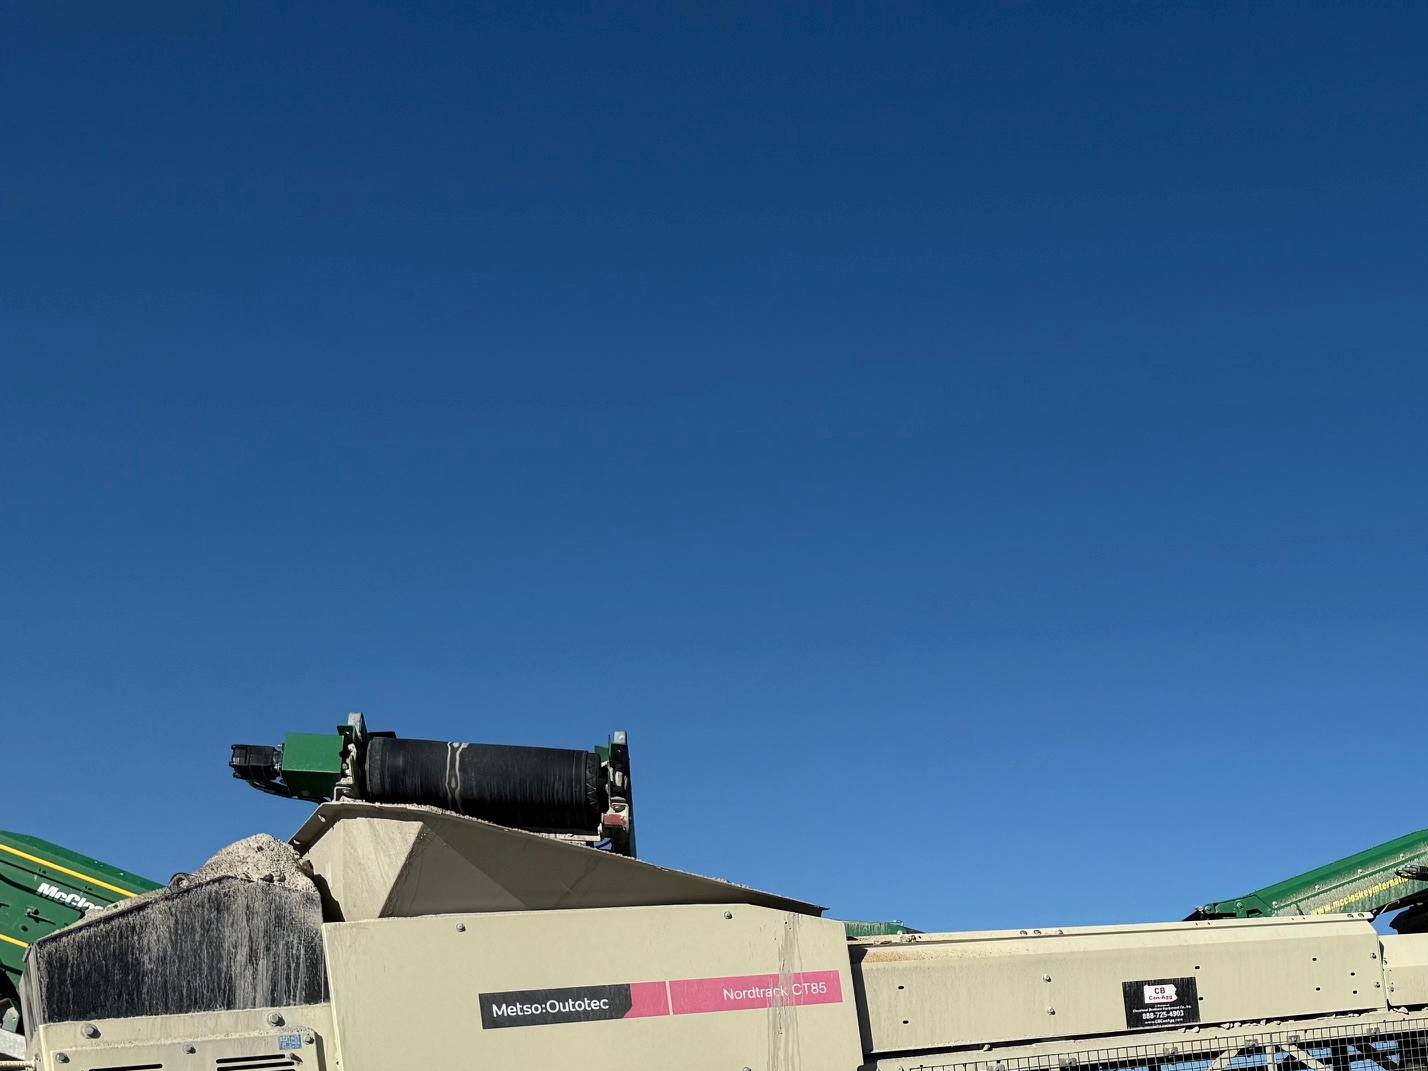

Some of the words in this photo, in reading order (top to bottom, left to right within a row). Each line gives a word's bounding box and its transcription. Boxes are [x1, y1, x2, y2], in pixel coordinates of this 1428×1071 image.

[722, 984, 789, 1000] Nordtrack
[792, 982, 828, 996] CT85
[492, 998, 609, 1017] Metso:Outotec
